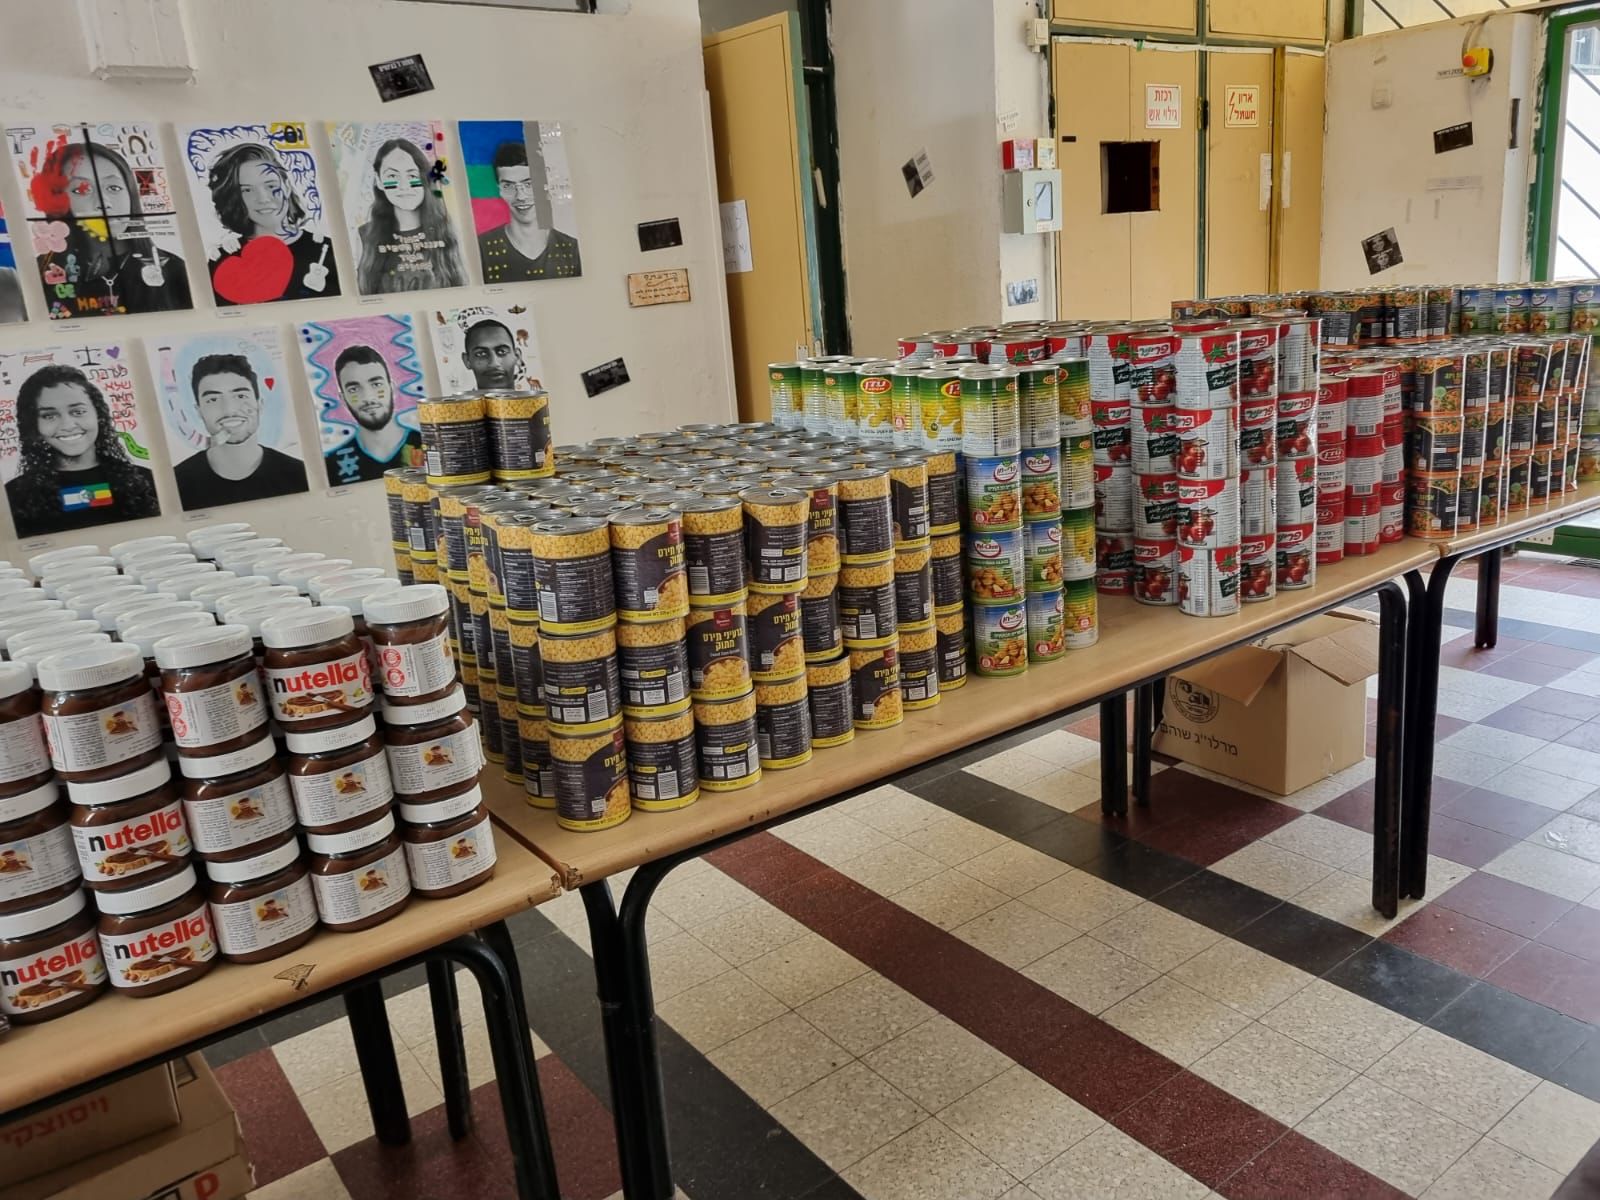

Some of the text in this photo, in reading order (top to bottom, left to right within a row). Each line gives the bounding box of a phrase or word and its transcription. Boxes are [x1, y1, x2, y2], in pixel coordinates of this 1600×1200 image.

[1238, 92, 1253, 105] ארון
[1148, 105, 1178, 121] גילוי אש
[1234, 108, 1256, 121] חשמל
[702, 632, 723, 643] תירס
[715, 639, 735, 652] מתוק
[273, 662, 359, 694] nutella
[88, 809, 183, 852] nutella
[114, 916, 206, 960] nutella
[0, 937, 97, 987] nutella
